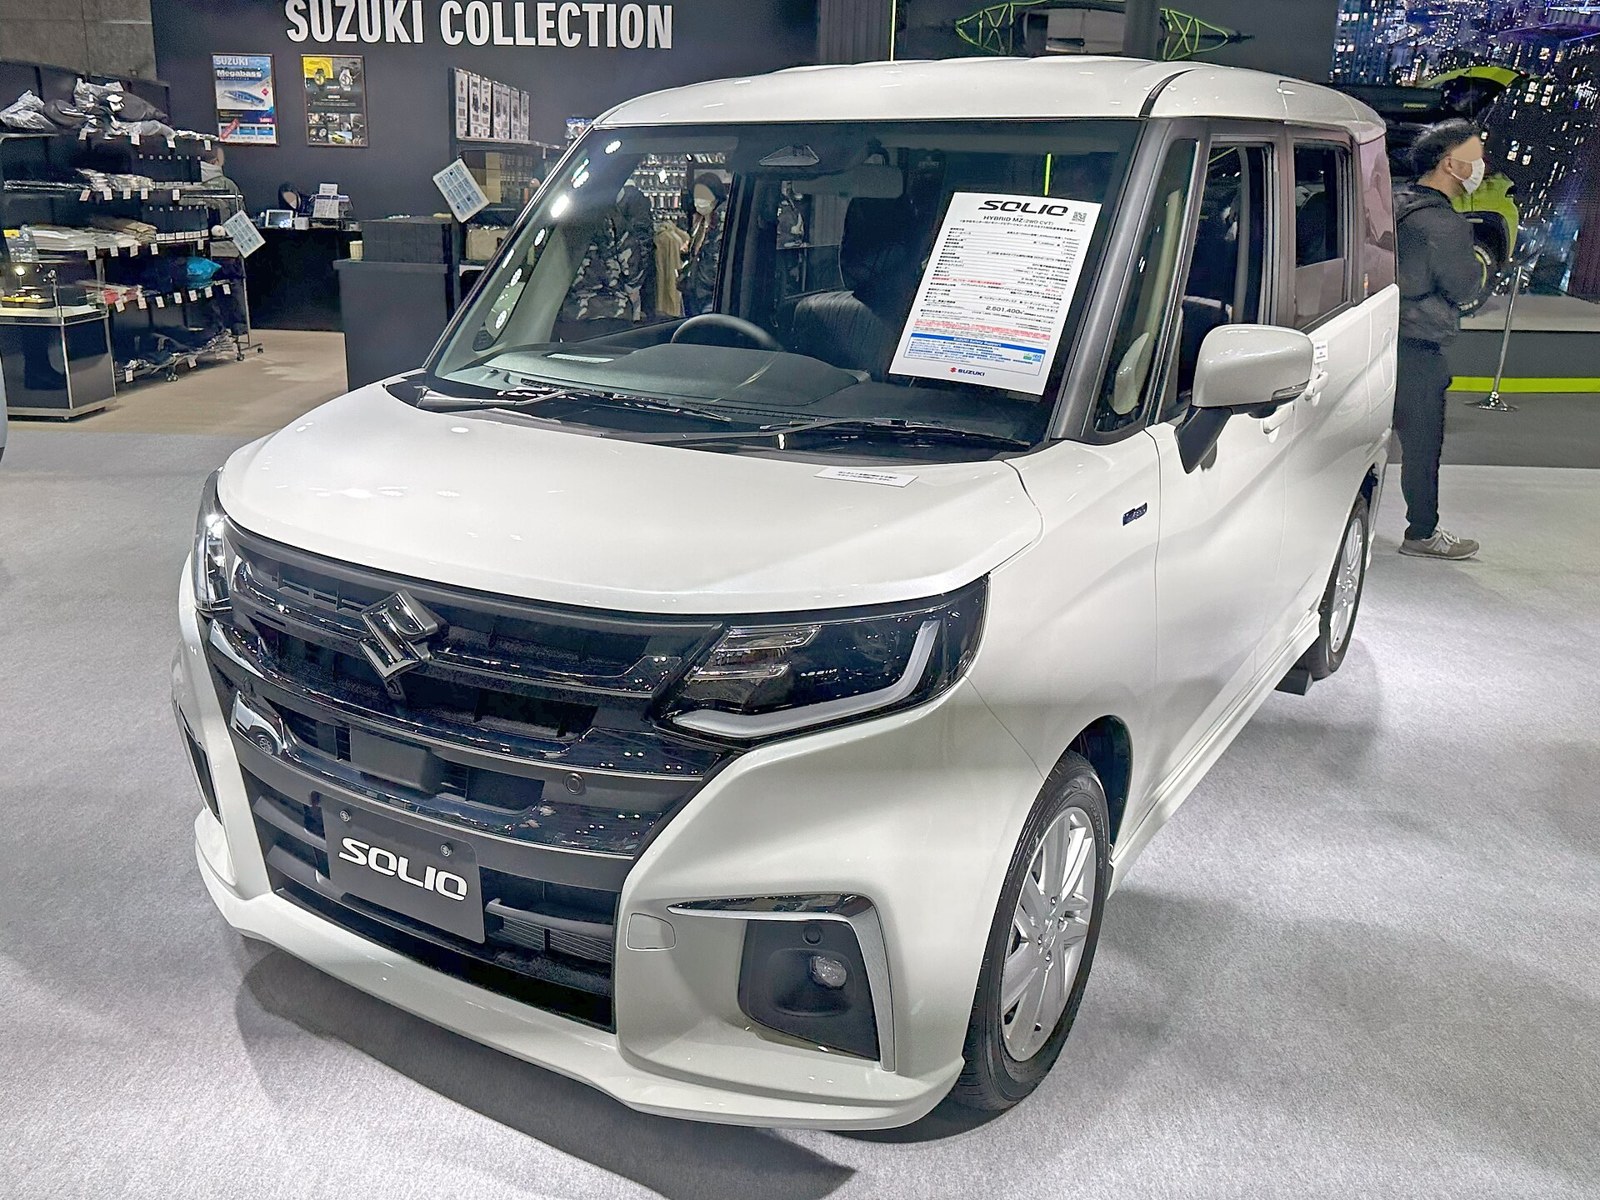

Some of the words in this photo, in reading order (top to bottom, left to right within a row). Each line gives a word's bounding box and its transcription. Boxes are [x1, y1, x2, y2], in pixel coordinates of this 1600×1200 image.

[284, 0, 424, 43] SUZUKI
[440, 0, 673, 49] COLLECTION
[215, 56, 249, 66] SUZUKI
[216, 69, 262, 78] Megabass
[978, 200, 1069, 217] SOLIO
[957, 368, 986, 377] SUZUKI
[338, 837, 468, 901] SOLIO
